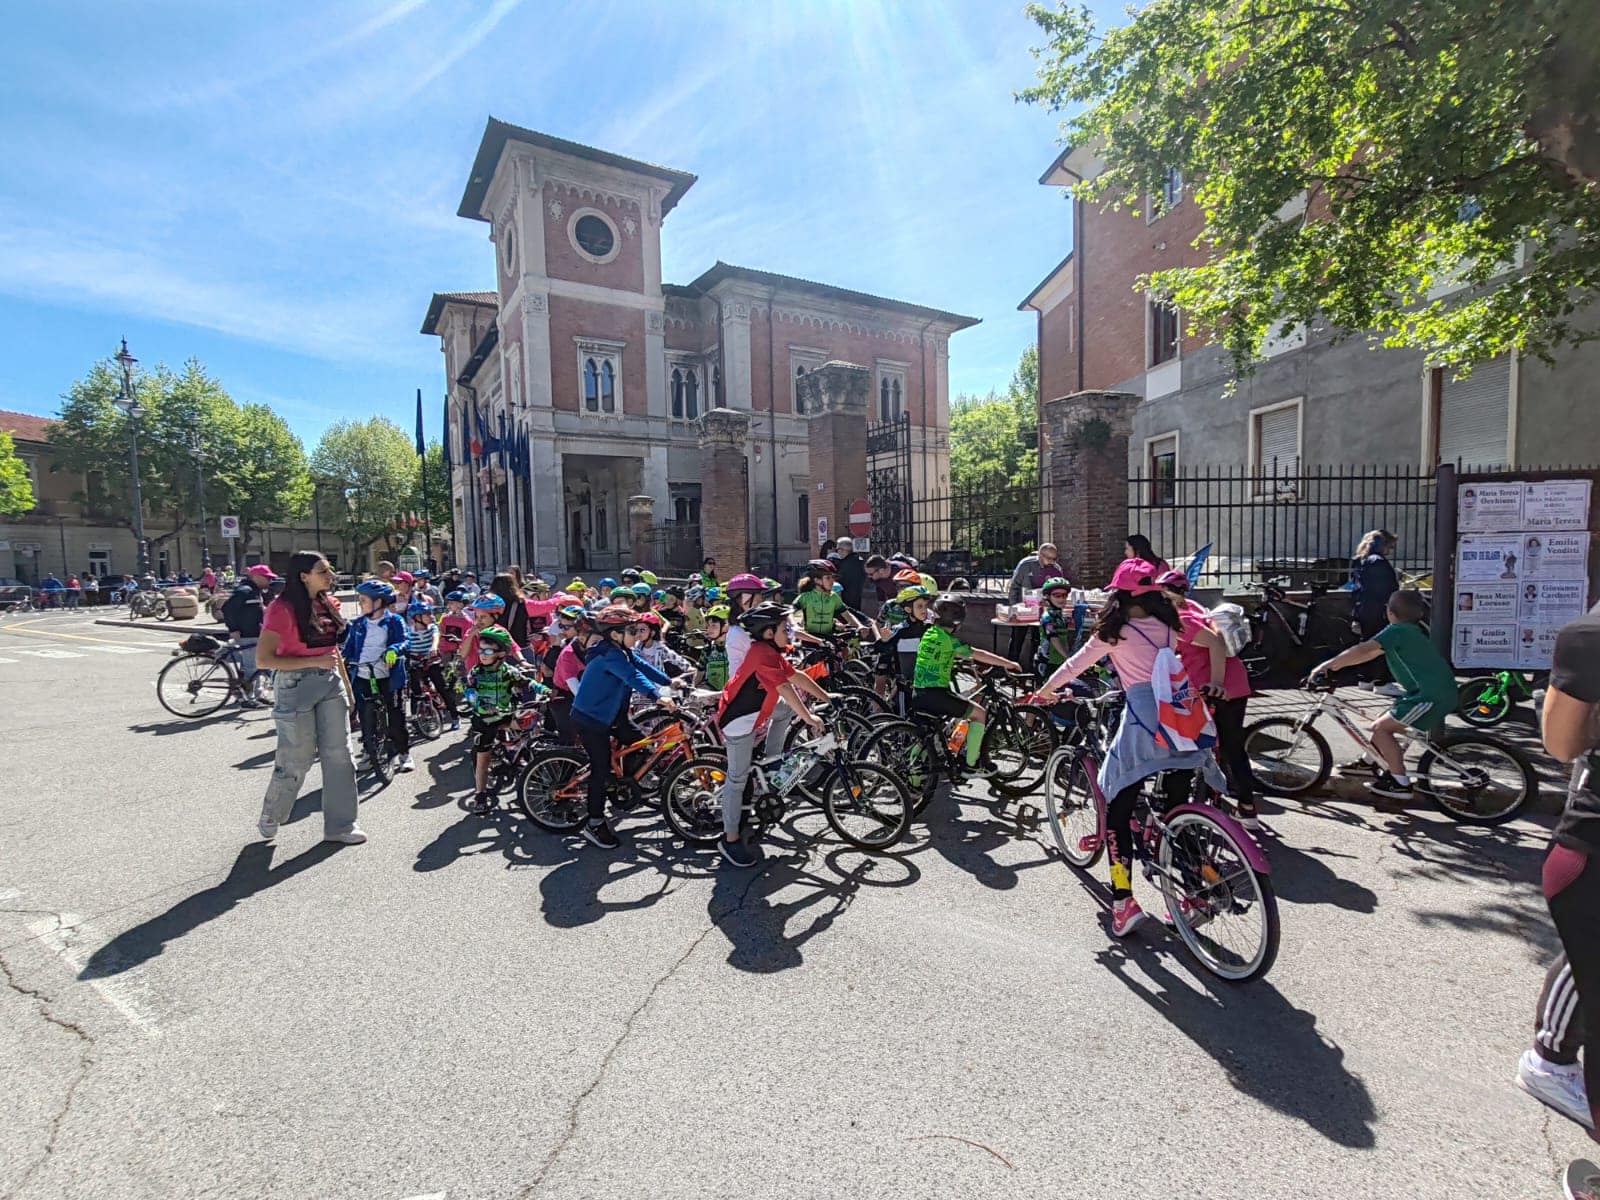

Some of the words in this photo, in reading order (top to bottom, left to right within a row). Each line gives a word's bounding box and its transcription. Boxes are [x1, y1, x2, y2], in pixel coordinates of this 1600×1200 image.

[1528, 518, 1552, 526] Maria
[1555, 517, 1581, 525] Teresa
[1549, 538, 1579, 546] Emilia
[1482, 629, 1506, 637] Giulio
